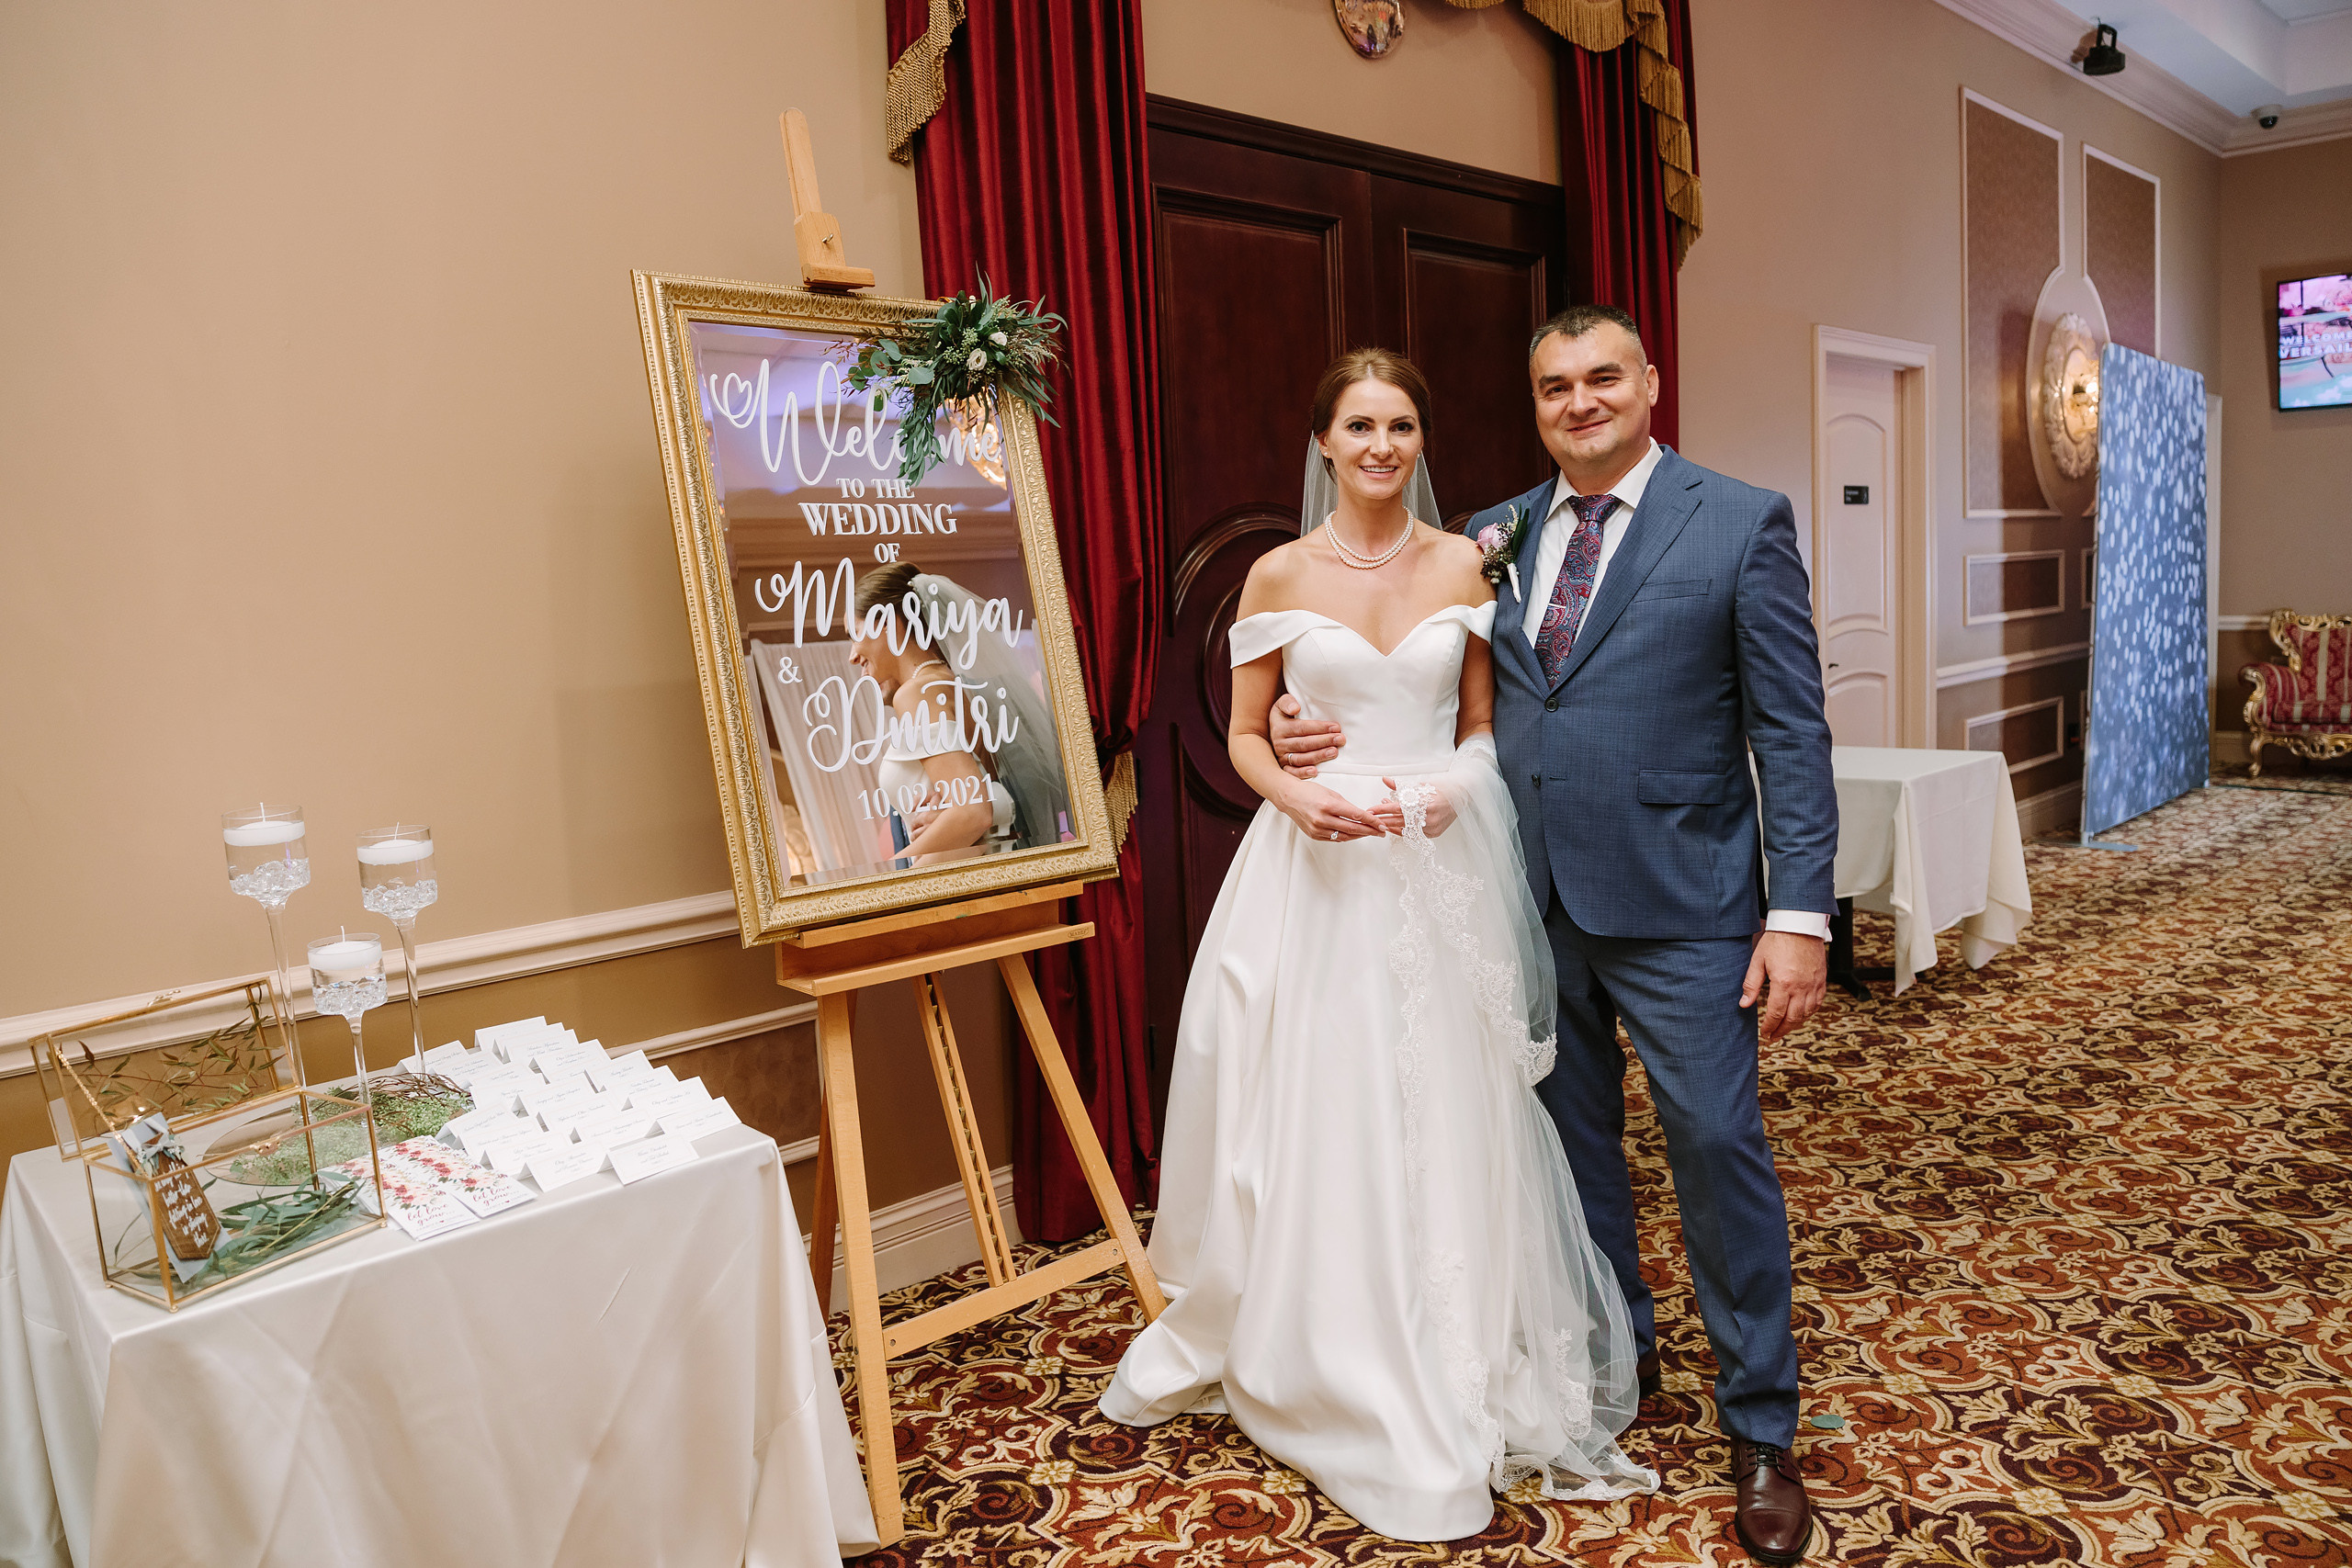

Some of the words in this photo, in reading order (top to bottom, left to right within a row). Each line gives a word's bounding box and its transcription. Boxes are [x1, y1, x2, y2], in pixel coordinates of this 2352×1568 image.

[2280, 331, 2352, 346] WELCOME
[709, 359, 1001, 486] Welcme
[835, 478, 865, 499] TO
[870, 478, 915, 500] THE
[798, 502, 957, 536] WEDDING
[874, 542, 900, 564] OF
[755, 557, 1023, 671] Mariya
[777, 656, 803, 684] &
[802, 675, 1020, 773] Dmitri
[857, 773, 998, 820] 10.02.2021
